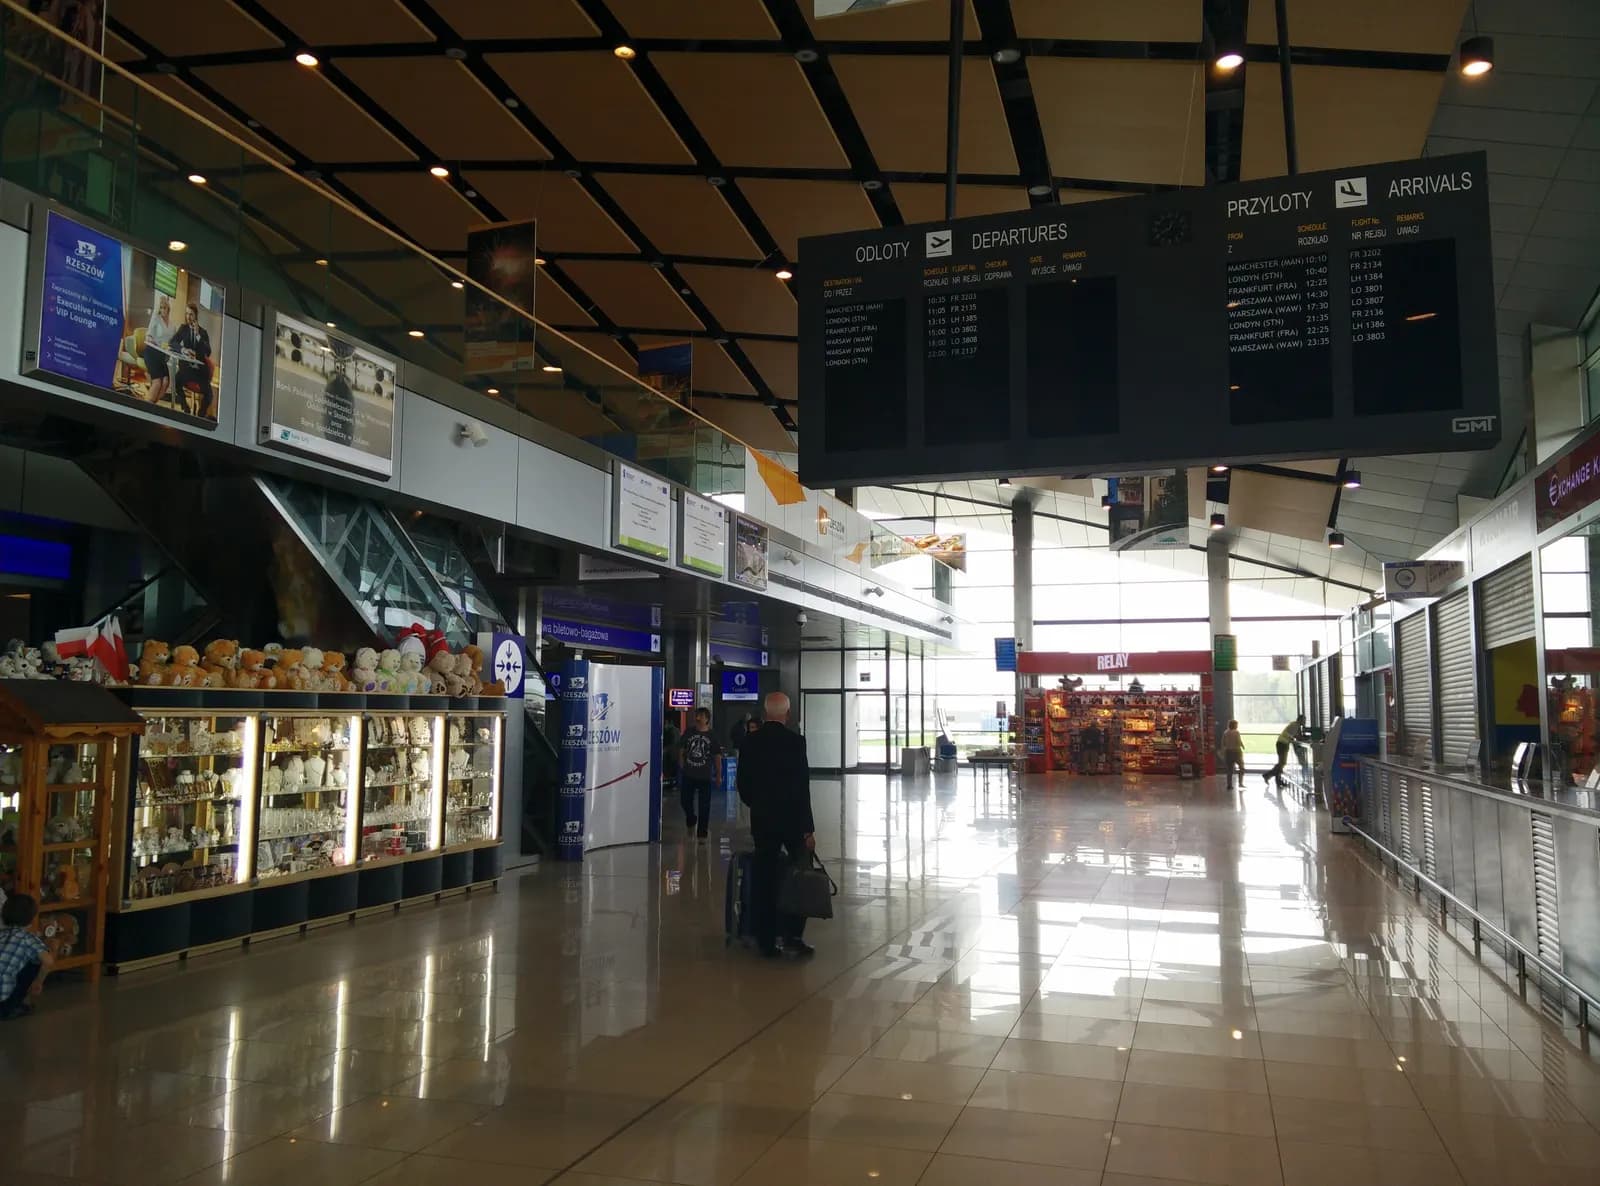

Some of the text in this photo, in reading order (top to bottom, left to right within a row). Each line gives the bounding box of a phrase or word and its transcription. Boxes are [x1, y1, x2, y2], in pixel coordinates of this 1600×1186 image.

[1227, 172, 1473, 218] PRZYLOTY ARRIVALS
[1297, 223, 1328, 233] SCHEDULE
[1396, 212, 1425, 223] REMARKS
[1352, 232, 1362, 241] NR
[1365, 229, 1387, 240] REJSU
[1397, 225, 1420, 236] UWAGI
[856, 223, 1069, 263] ODLOTY DEPARTURES
[1350, 248, 1382, 259] FR 3202
[65, 255, 105, 281] RZESZÓW
[1062, 264, 1082, 274] UWAGI
[1228, 255, 1328, 272] MANCHESTER (MAN) 10:10
[1350, 261, 1383, 271] FR 2134
[1228, 267, 1328, 284] LONDYN (STN) 10:40
[1351, 272, 1384, 283] LH 1384
[1228, 279, 1328, 295] FRANKFURT (FRA) 12:25
[1351, 284, 1384, 295] LO 3801
[1275, 293, 1302, 304] (WAW)
[1306, 290, 1329, 299] 14:30
[1351, 296, 1385, 307] LO 3807
[56, 294, 92, 316] Executive
[92, 307, 118, 327] Lounge
[56, 305, 97, 329] VIP Lounge
[1229, 302, 1329, 319] WARSZAWA (WAW) 17:30
[1352, 308, 1385, 318] FR 2136
[826, 316, 850, 325] LONDON
[950, 315, 960, 324] LH
[1229, 314, 1329, 330] LONDYN (STN) 21:35
[1352, 320, 1386, 330] LH 1386
[826, 326, 860, 336] FRANKFURT
[1229, 326, 1329, 342] FRANKFURT (FRA) 22:25
[1353, 332, 1386, 343] LO 3803
[826, 337, 852, 345] WARSAW
[950, 337, 961, 345] LO
[1230, 338, 1330, 354] WARSZAWA (WAW) 23:35
[826, 348, 852, 356] WARSAW
[826, 359, 851, 368] LONDON
[1452, 415, 1497, 433] GMT
[1097, 652, 1129, 671] RELAY
[588, 727, 621, 745] ZESZÓW
